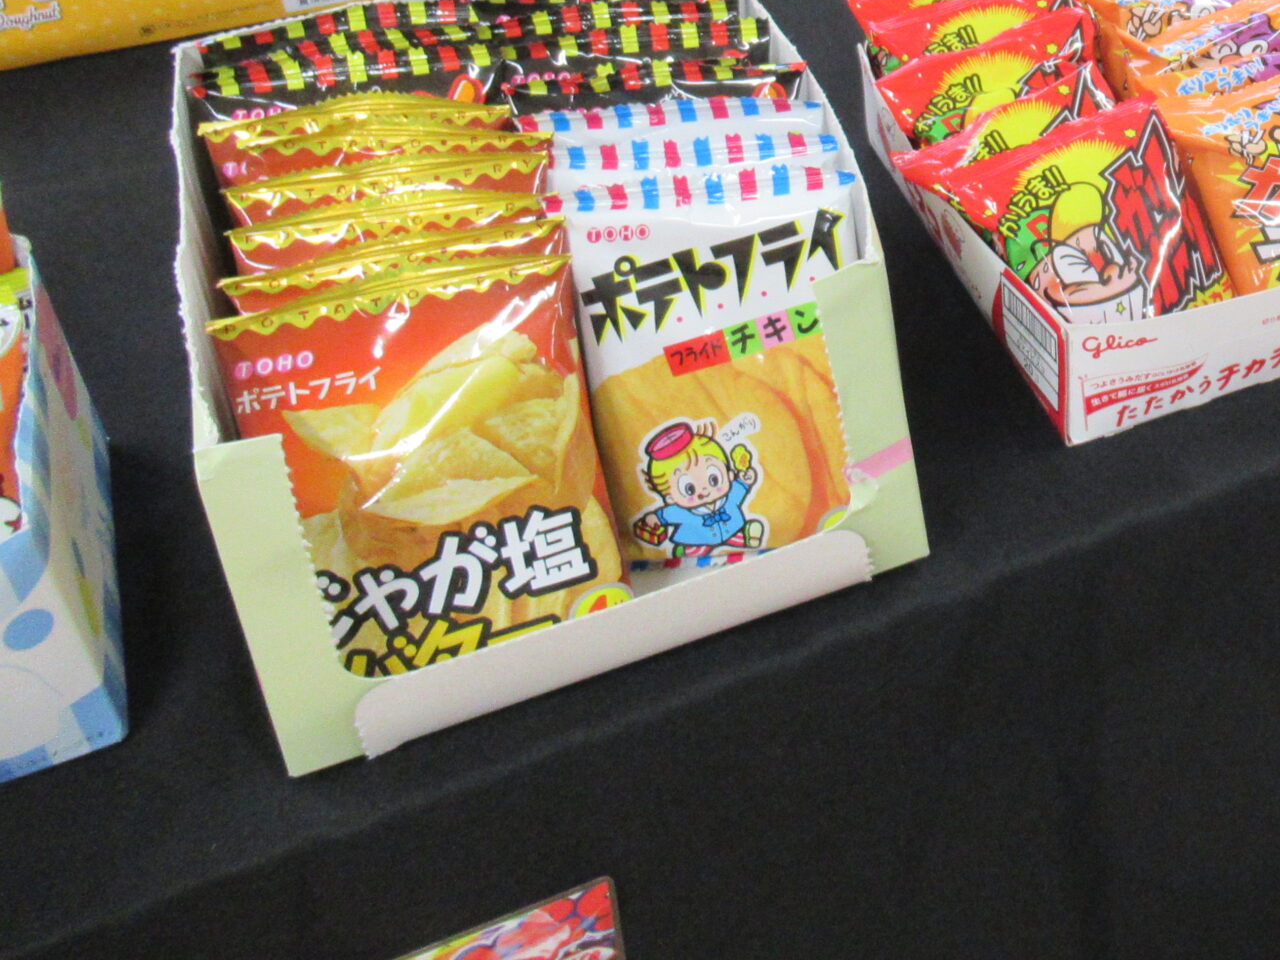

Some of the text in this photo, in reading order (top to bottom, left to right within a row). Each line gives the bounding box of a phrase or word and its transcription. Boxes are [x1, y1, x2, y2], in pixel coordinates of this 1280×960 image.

[586, 223, 651, 244] TOHO
[579, 207, 848, 348] ポテトフライ
[1081, 335, 1159, 360] Glico
[234, 350, 314, 379] TOHO
[235, 365, 382, 415] ポテトフライ
